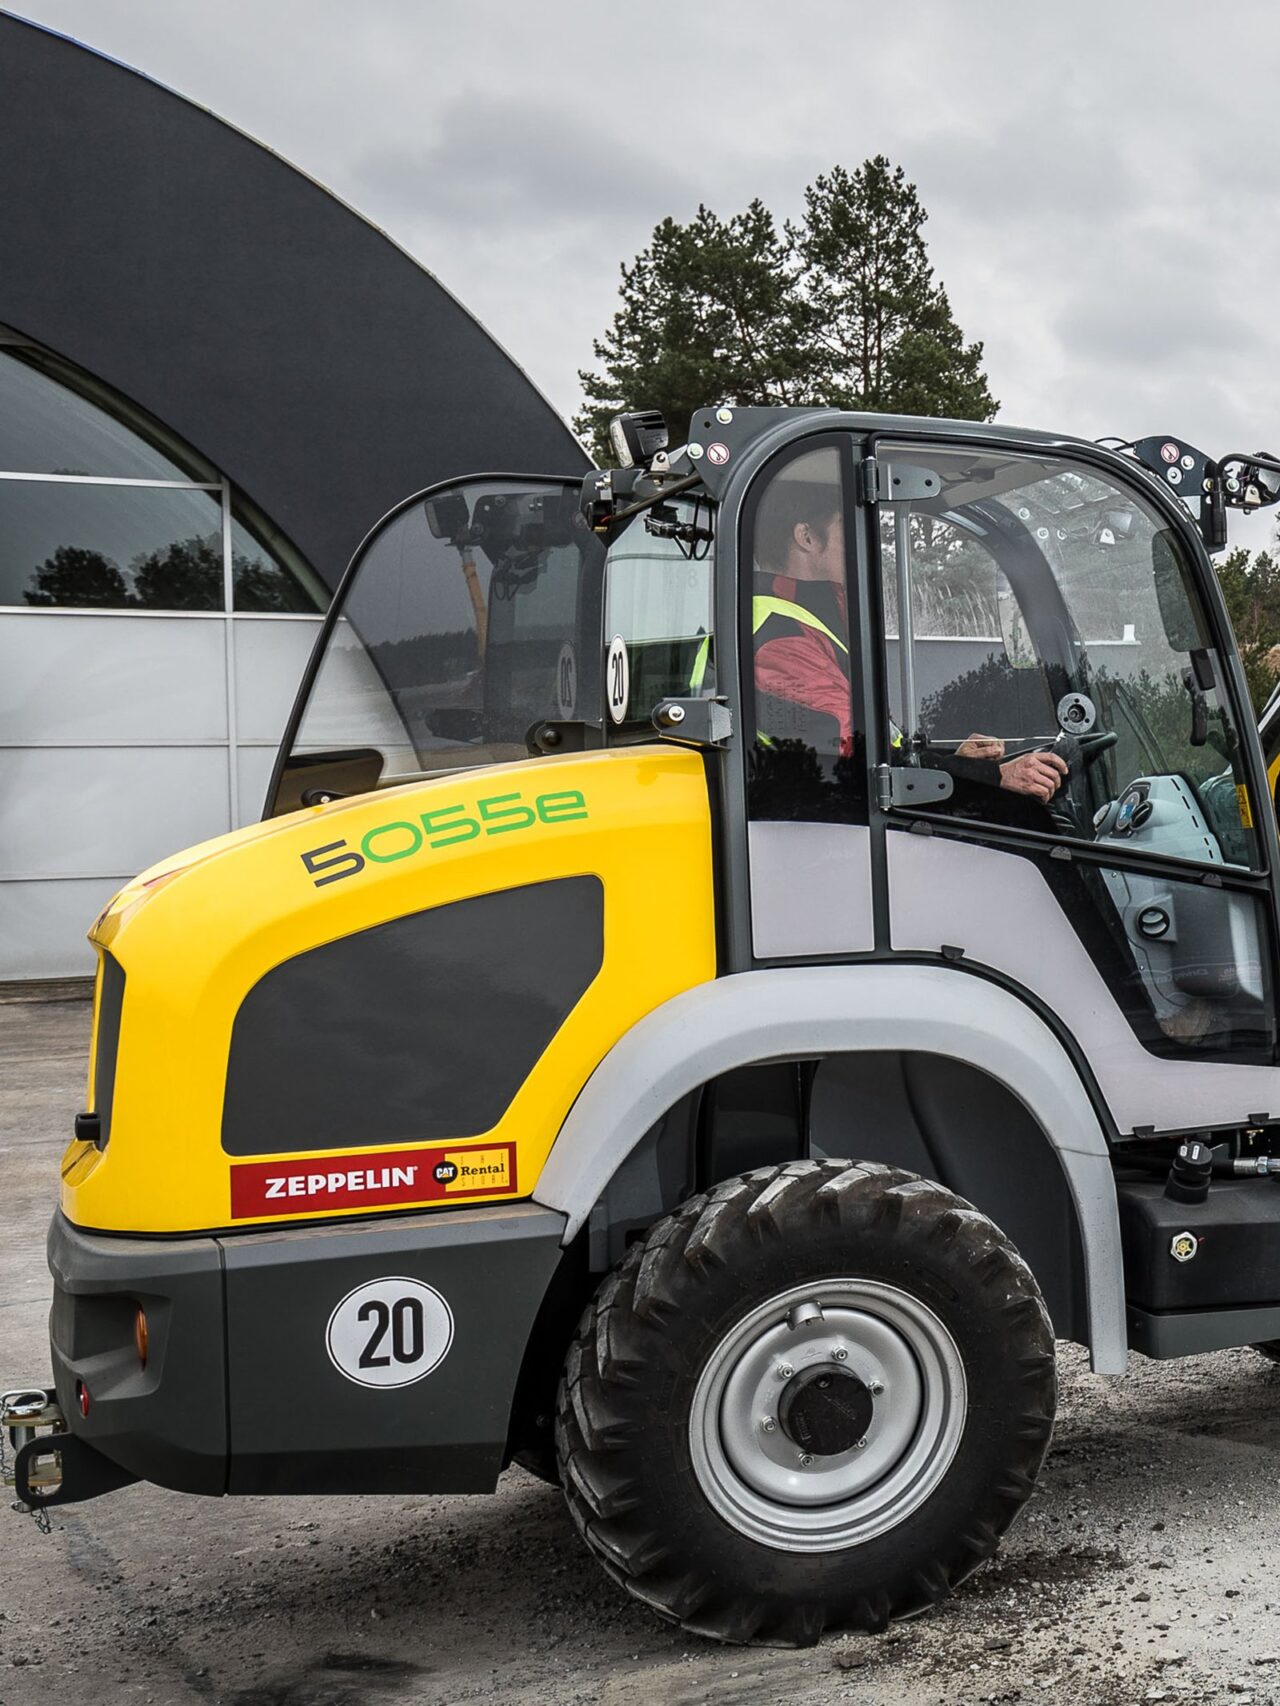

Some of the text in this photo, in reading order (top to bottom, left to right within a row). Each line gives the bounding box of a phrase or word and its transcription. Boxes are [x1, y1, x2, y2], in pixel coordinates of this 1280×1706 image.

[612, 651, 624, 706] 20
[300, 790, 588, 887] 5055e
[265, 1163, 504, 1198] ZEPPELIN CAT Rental
[358, 1297, 424, 1368] 20
